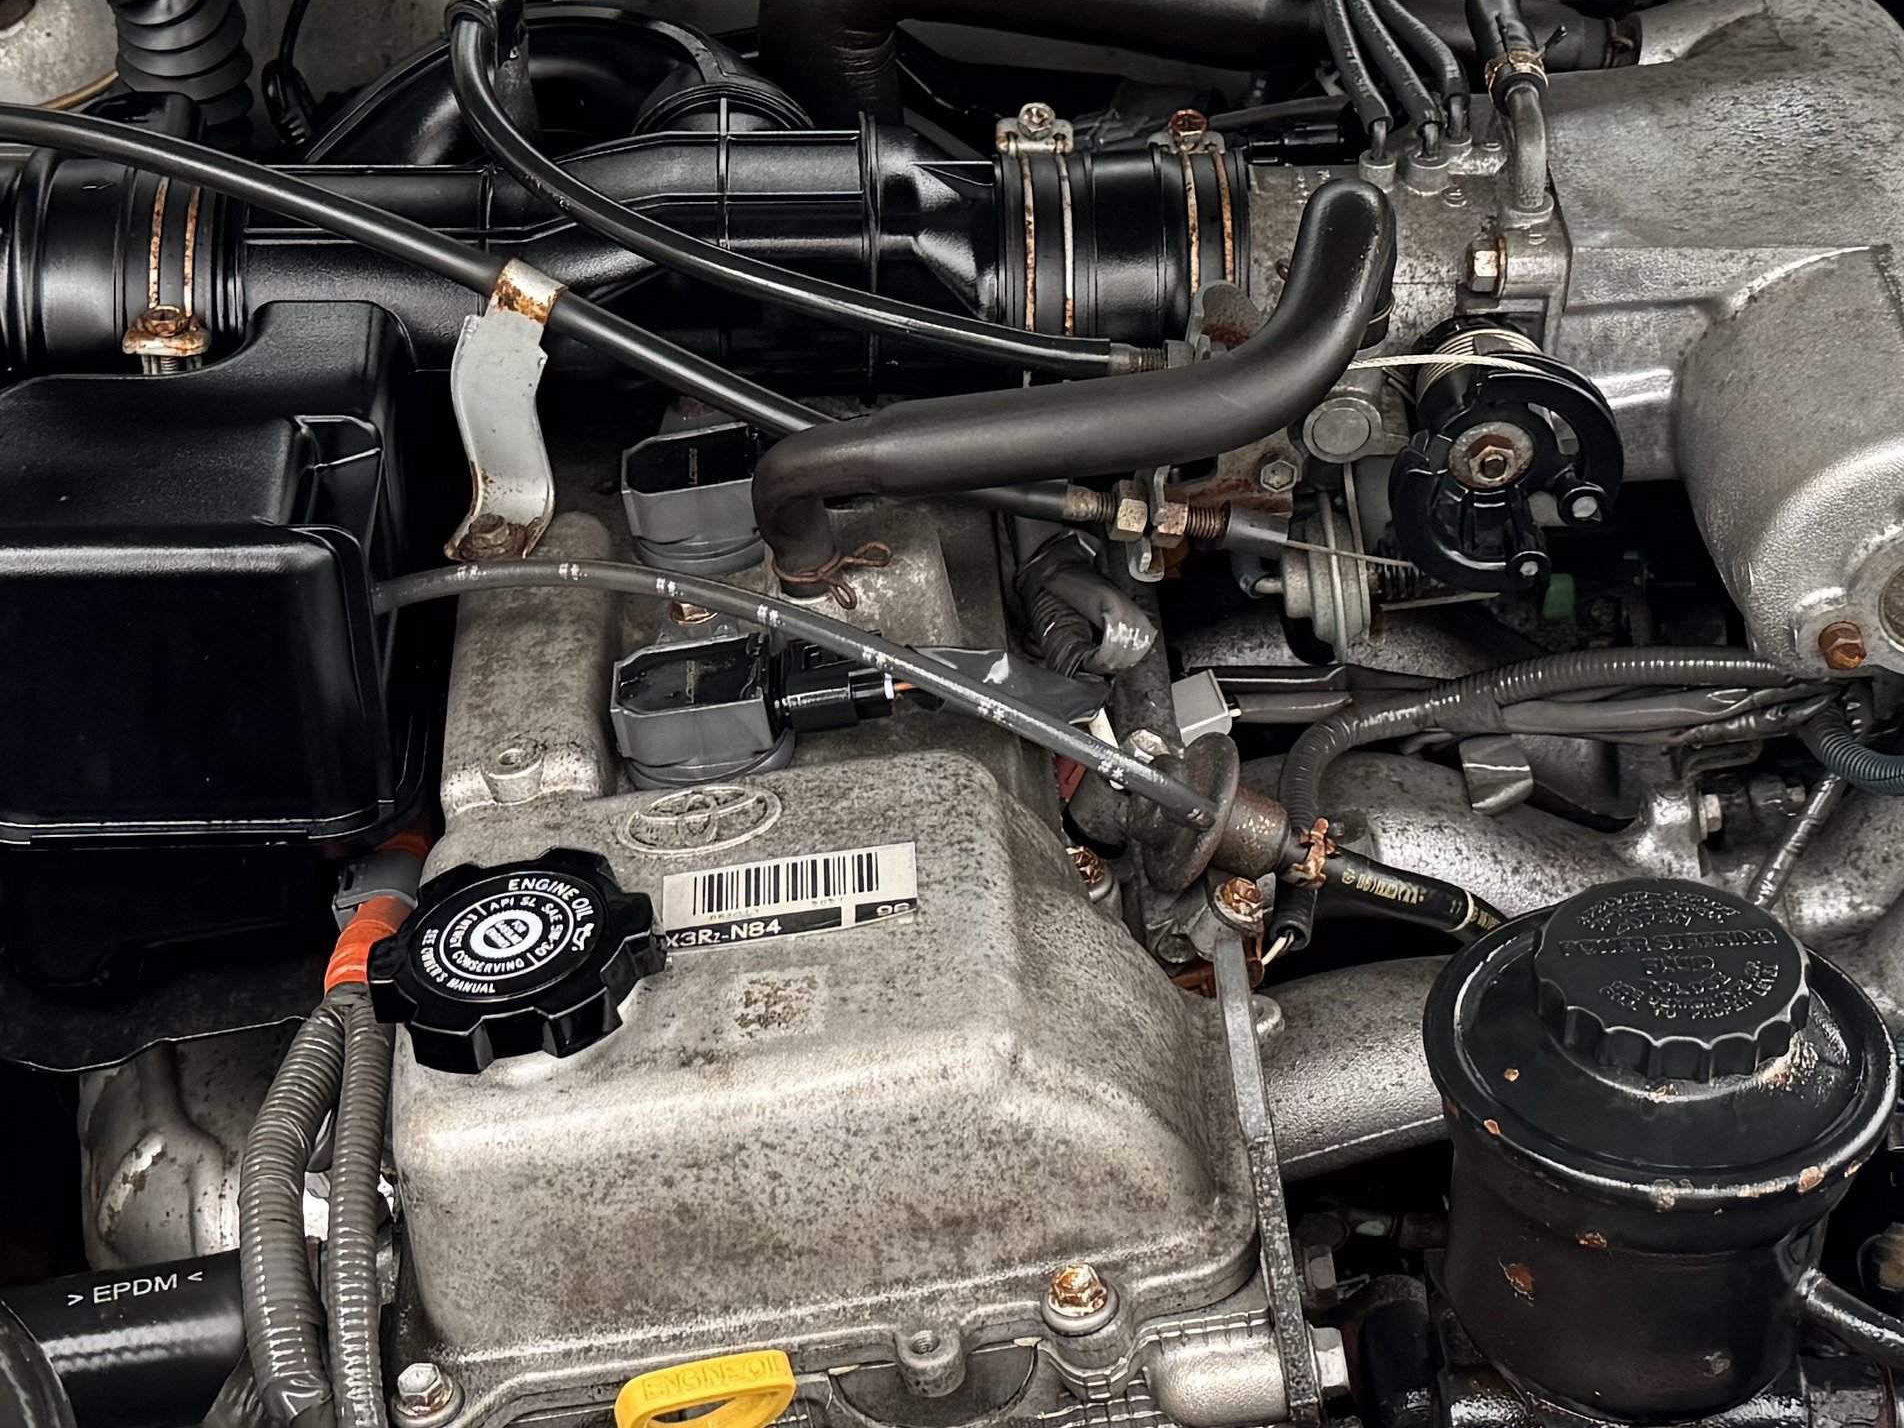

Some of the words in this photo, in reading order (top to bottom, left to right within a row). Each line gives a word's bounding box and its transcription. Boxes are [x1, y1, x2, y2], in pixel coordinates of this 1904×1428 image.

[490, 898, 515, 912] API
[519, 895, 538, 908] SL
[541, 902, 564, 924] SAE
[508, 878, 580, 901] ENGINE
[571, 897, 594, 922] OIL
[421, 928, 439, 946] SEE
[446, 977, 497, 994] MANUAL
[452, 951, 525, 974] CONSERVING
[93, 1273, 178, 1304] EPDM
[642, 1362, 741, 1401] ENGINE
[743, 1355, 788, 1382] OIL
